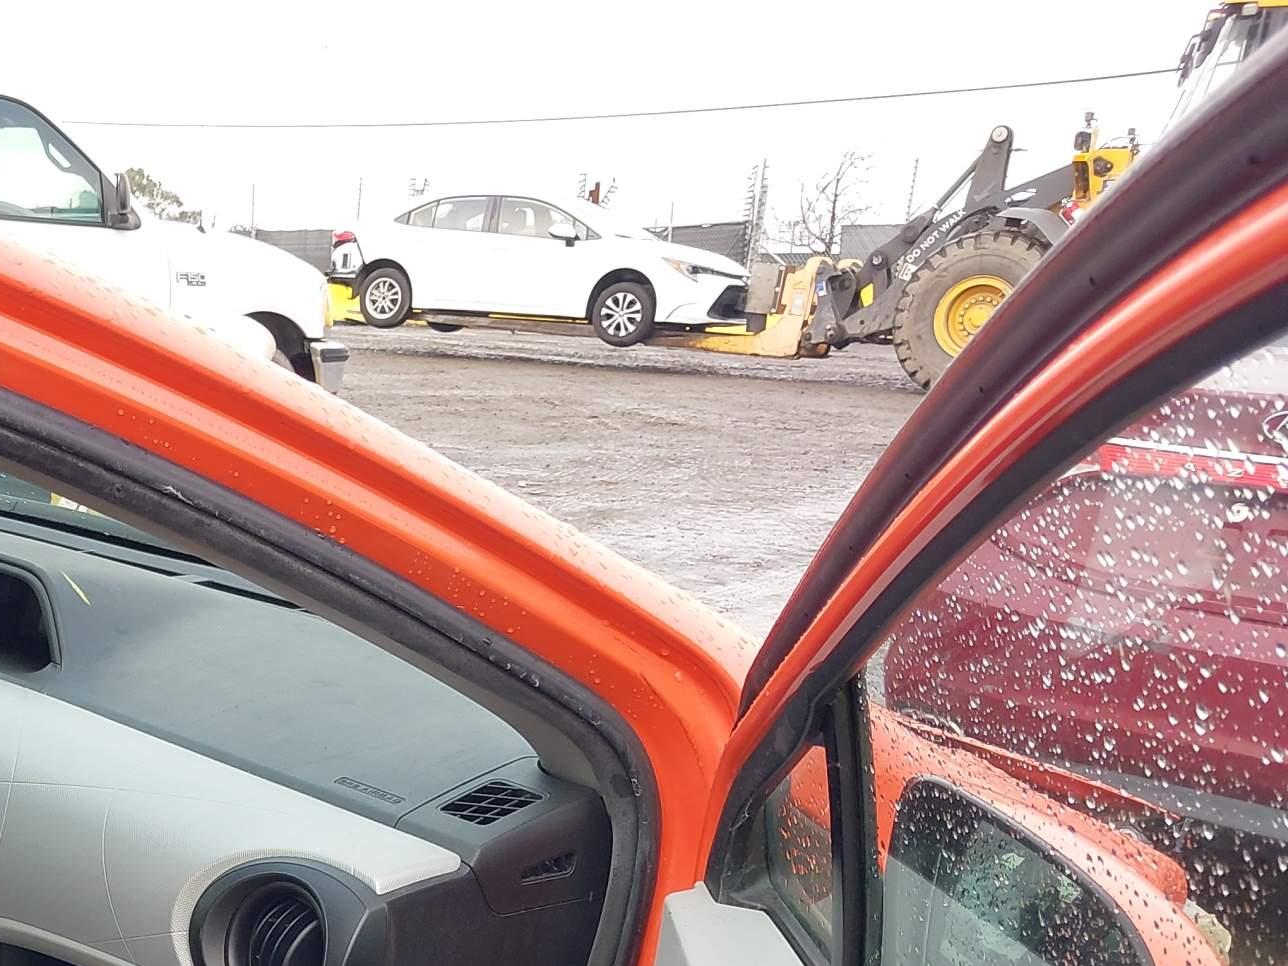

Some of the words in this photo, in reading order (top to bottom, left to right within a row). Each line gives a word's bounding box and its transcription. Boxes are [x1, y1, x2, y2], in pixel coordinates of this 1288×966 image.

[905, 248, 921, 263] DO
[919, 230, 940, 251] NOT
[938, 208, 967, 233] WALK
[360, 787, 402, 804] AIRBAG
